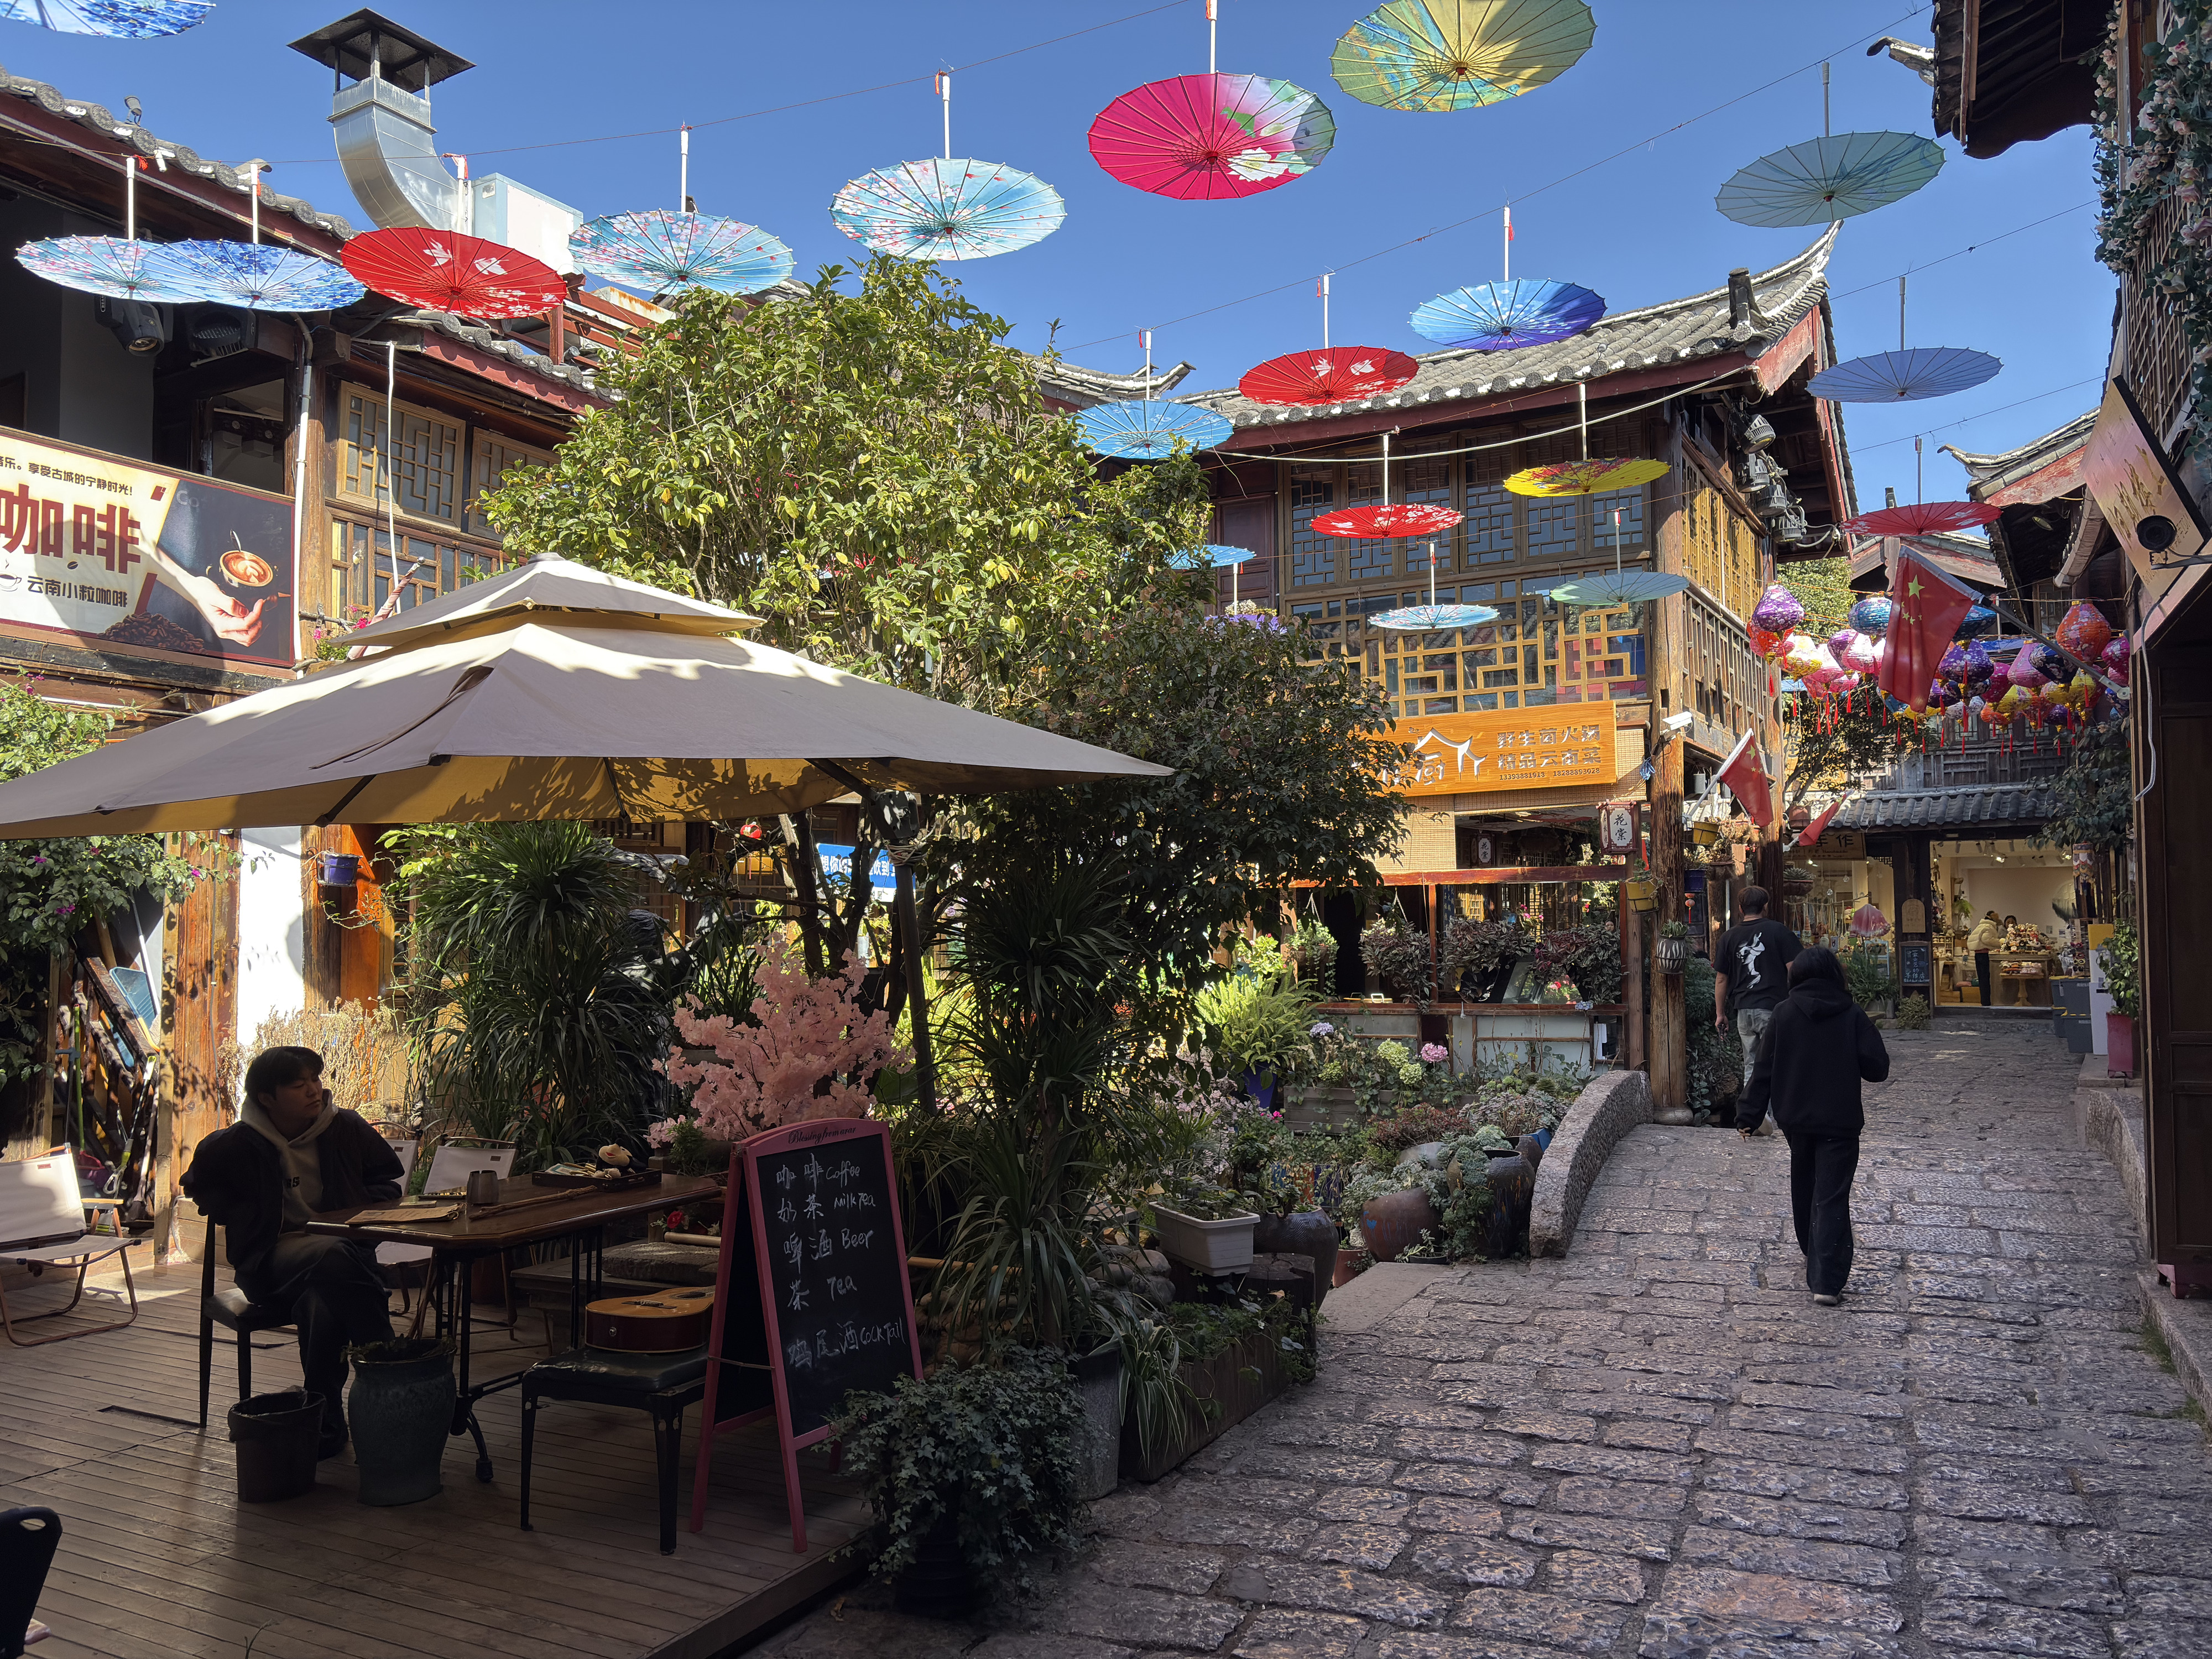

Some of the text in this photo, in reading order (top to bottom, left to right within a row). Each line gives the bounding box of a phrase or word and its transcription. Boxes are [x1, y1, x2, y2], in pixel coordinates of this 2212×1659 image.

[0, 483, 140, 574] 咖啡
[28, 576, 127, 607] 云南小粒咖啡
[1498, 724, 1600, 748] 野生菌火锅
[1498, 747, 1601, 770] 精品云南菜
[777, 1193, 824, 1223] 奶茶
[784, 1228, 874, 1274] 啤酒 Beer
[787, 1276, 857, 1311] 茶 Tea
